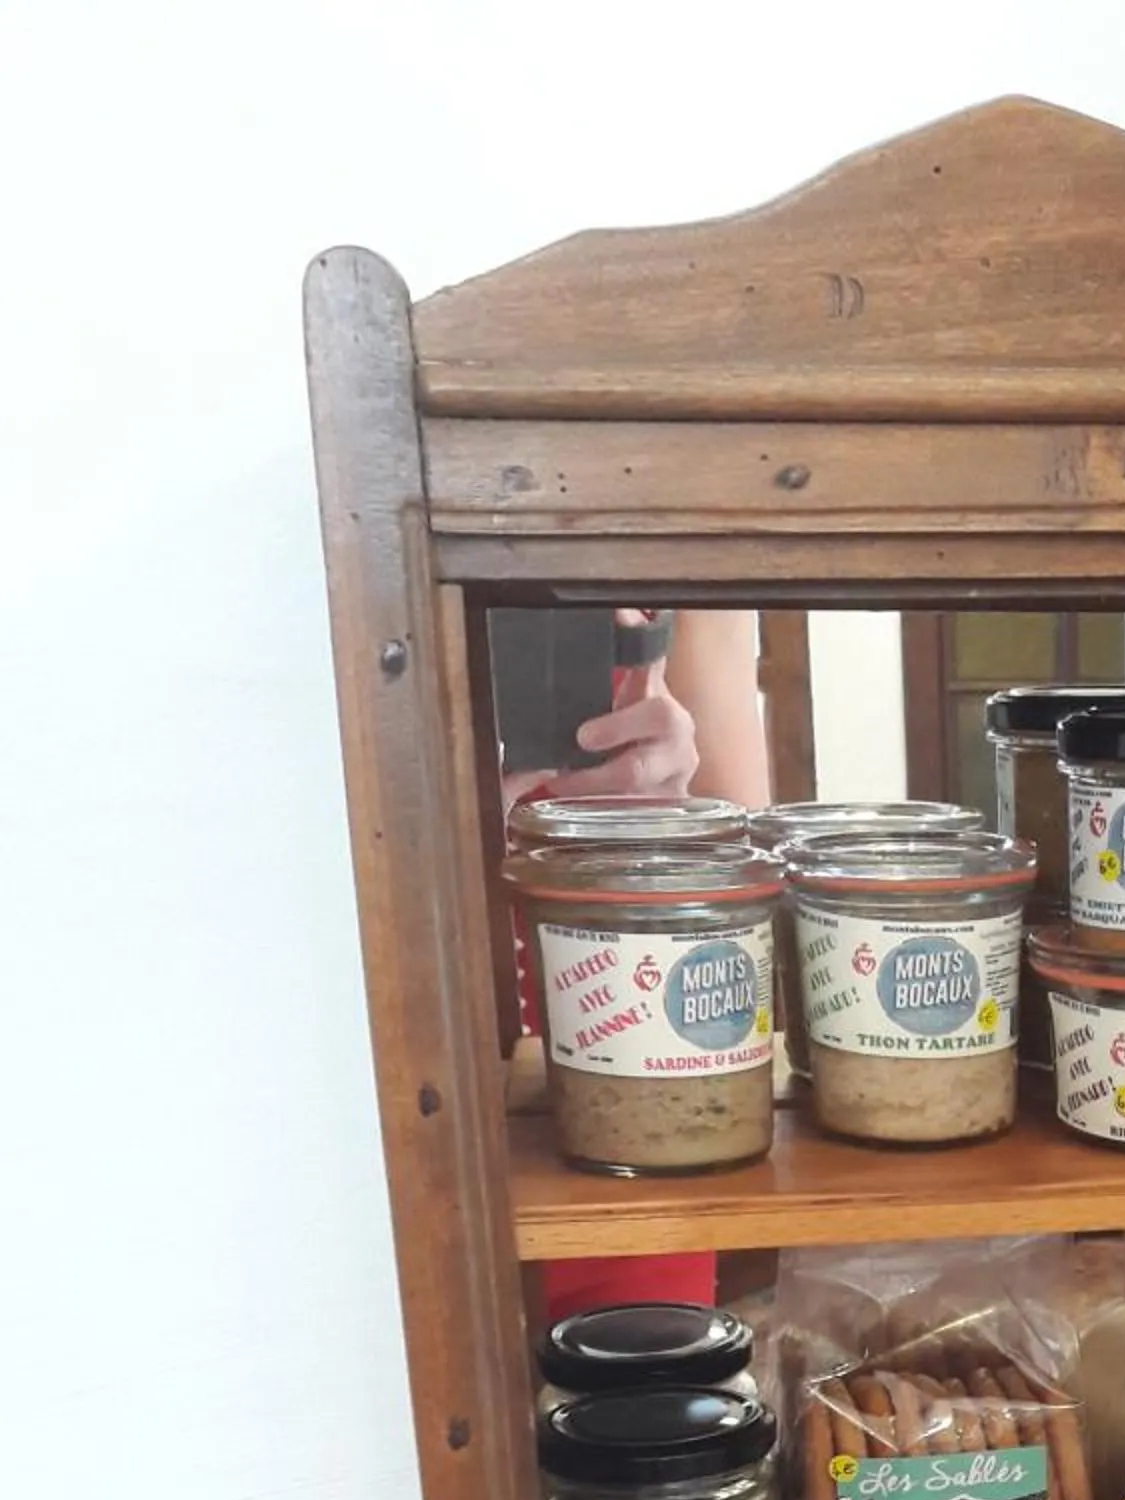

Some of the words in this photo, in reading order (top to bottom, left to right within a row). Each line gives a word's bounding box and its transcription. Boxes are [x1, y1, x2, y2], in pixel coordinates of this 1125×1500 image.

[682, 952, 747, 994] MONTS
[894, 950, 964, 981] MONTS
[683, 981, 755, 1025] BOCAUX
[895, 975, 974, 1010] BOCAUX
[856, 1033, 910, 1048] THON
[915, 1031, 996, 1050] TARTARE
[643, 1055, 712, 1071] SARDINE
[859, 1463, 916, 1495] Les
